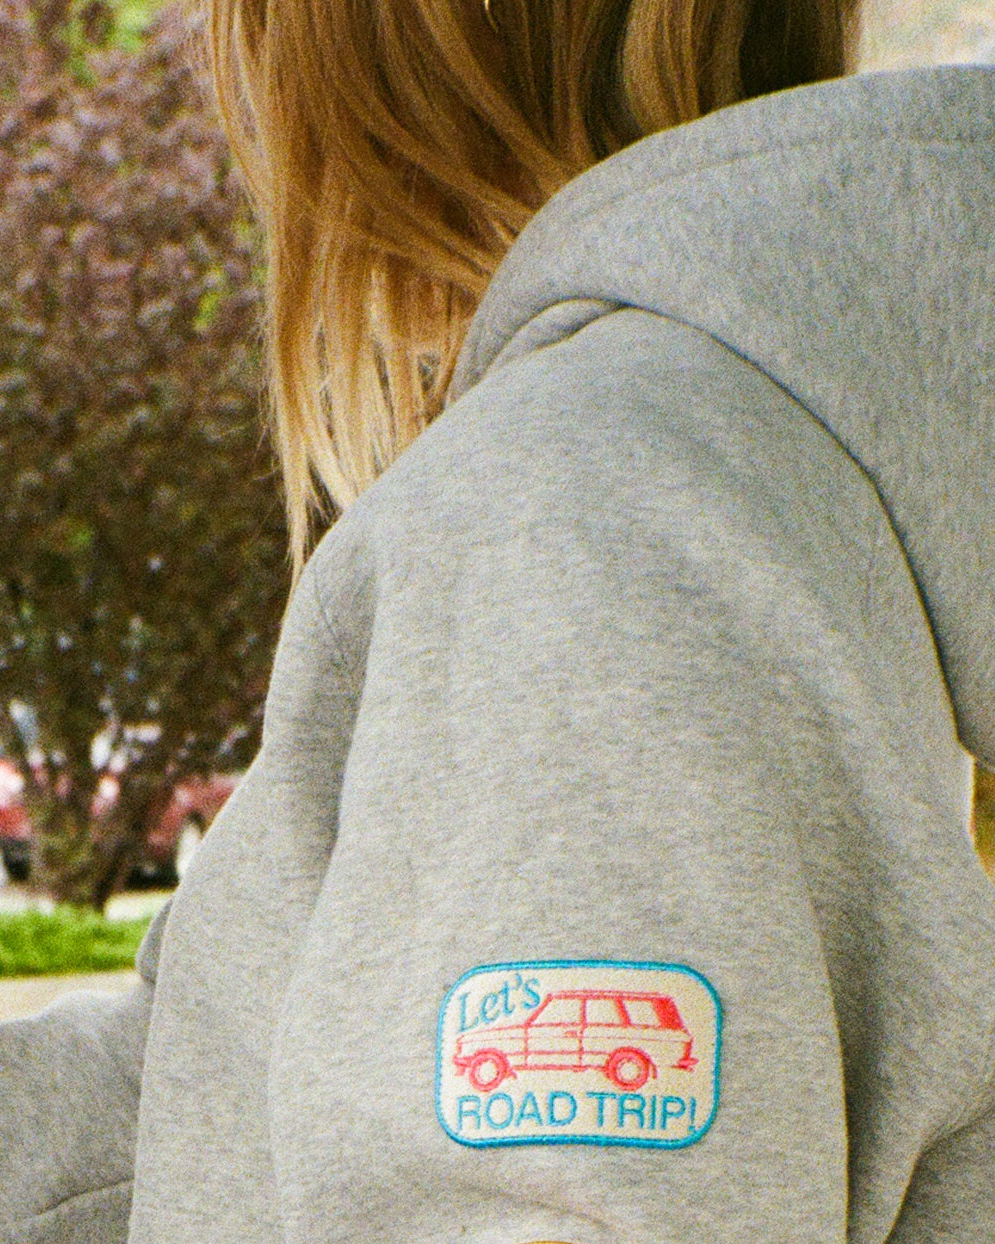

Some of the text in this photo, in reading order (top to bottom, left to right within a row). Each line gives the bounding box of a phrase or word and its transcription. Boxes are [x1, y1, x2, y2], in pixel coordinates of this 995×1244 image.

[456, 972, 542, 1033] Let's
[456, 1090, 698, 1133] ROAD TRIP!
